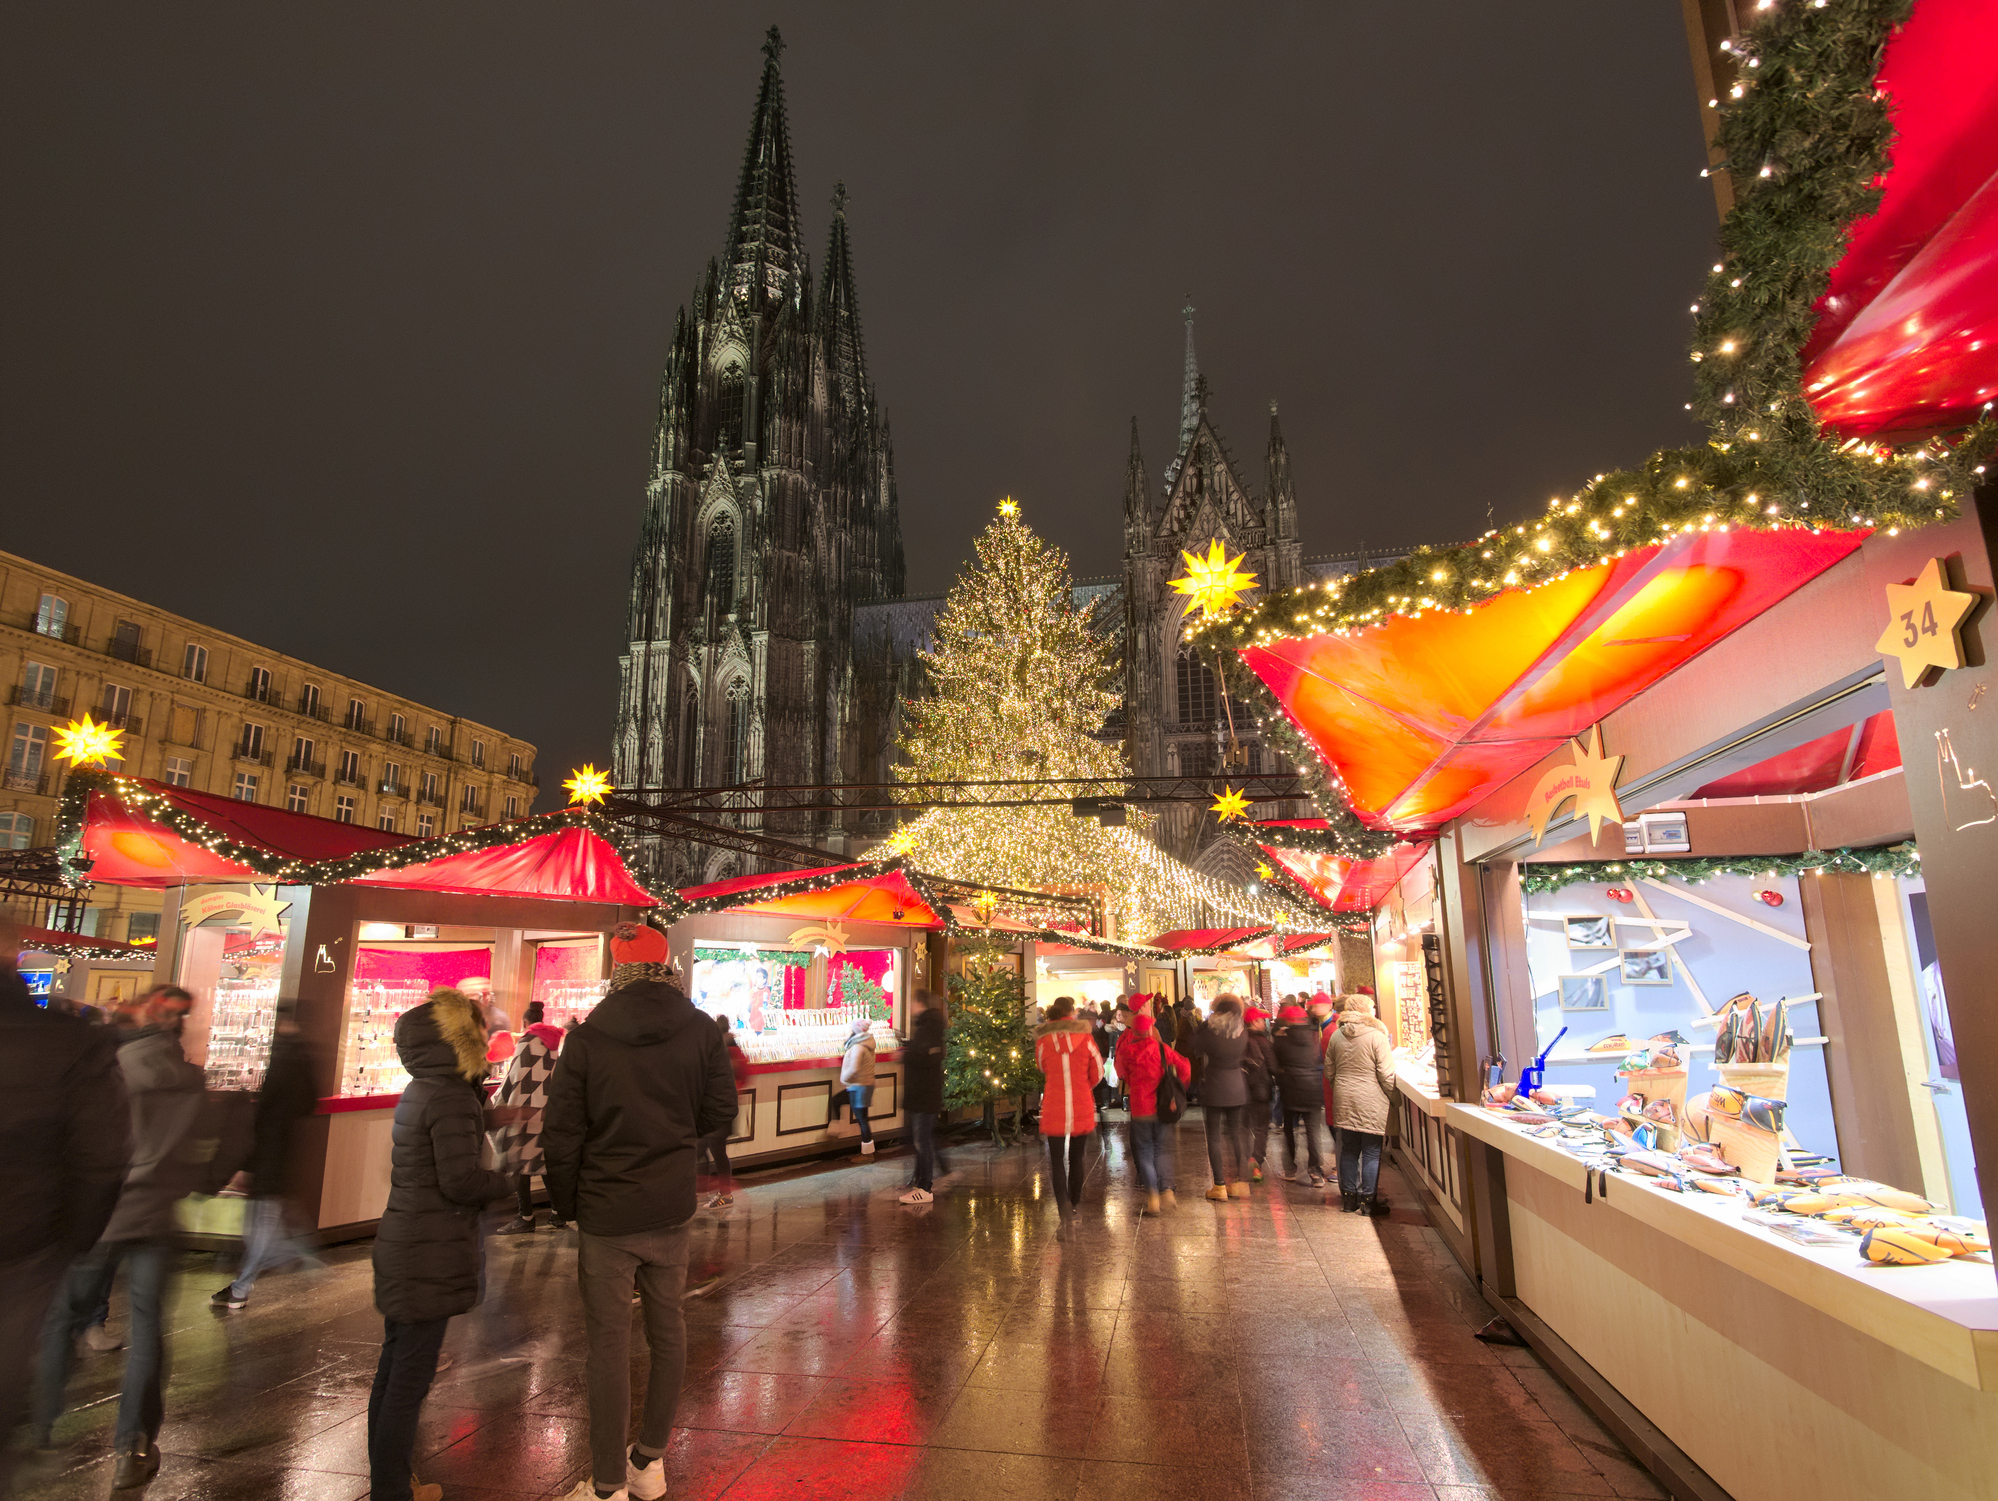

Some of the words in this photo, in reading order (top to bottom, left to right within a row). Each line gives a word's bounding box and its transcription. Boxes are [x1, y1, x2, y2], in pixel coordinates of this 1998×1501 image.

[1900, 600, 1939, 649] 34
[1544, 776, 1574, 804] Basketball
[1575, 775, 1591, 790] Etuis
[200, 894, 224, 905] domglas
[201, 903, 224, 914] Kölner
[225, 901, 267, 915] Glasbläserei
